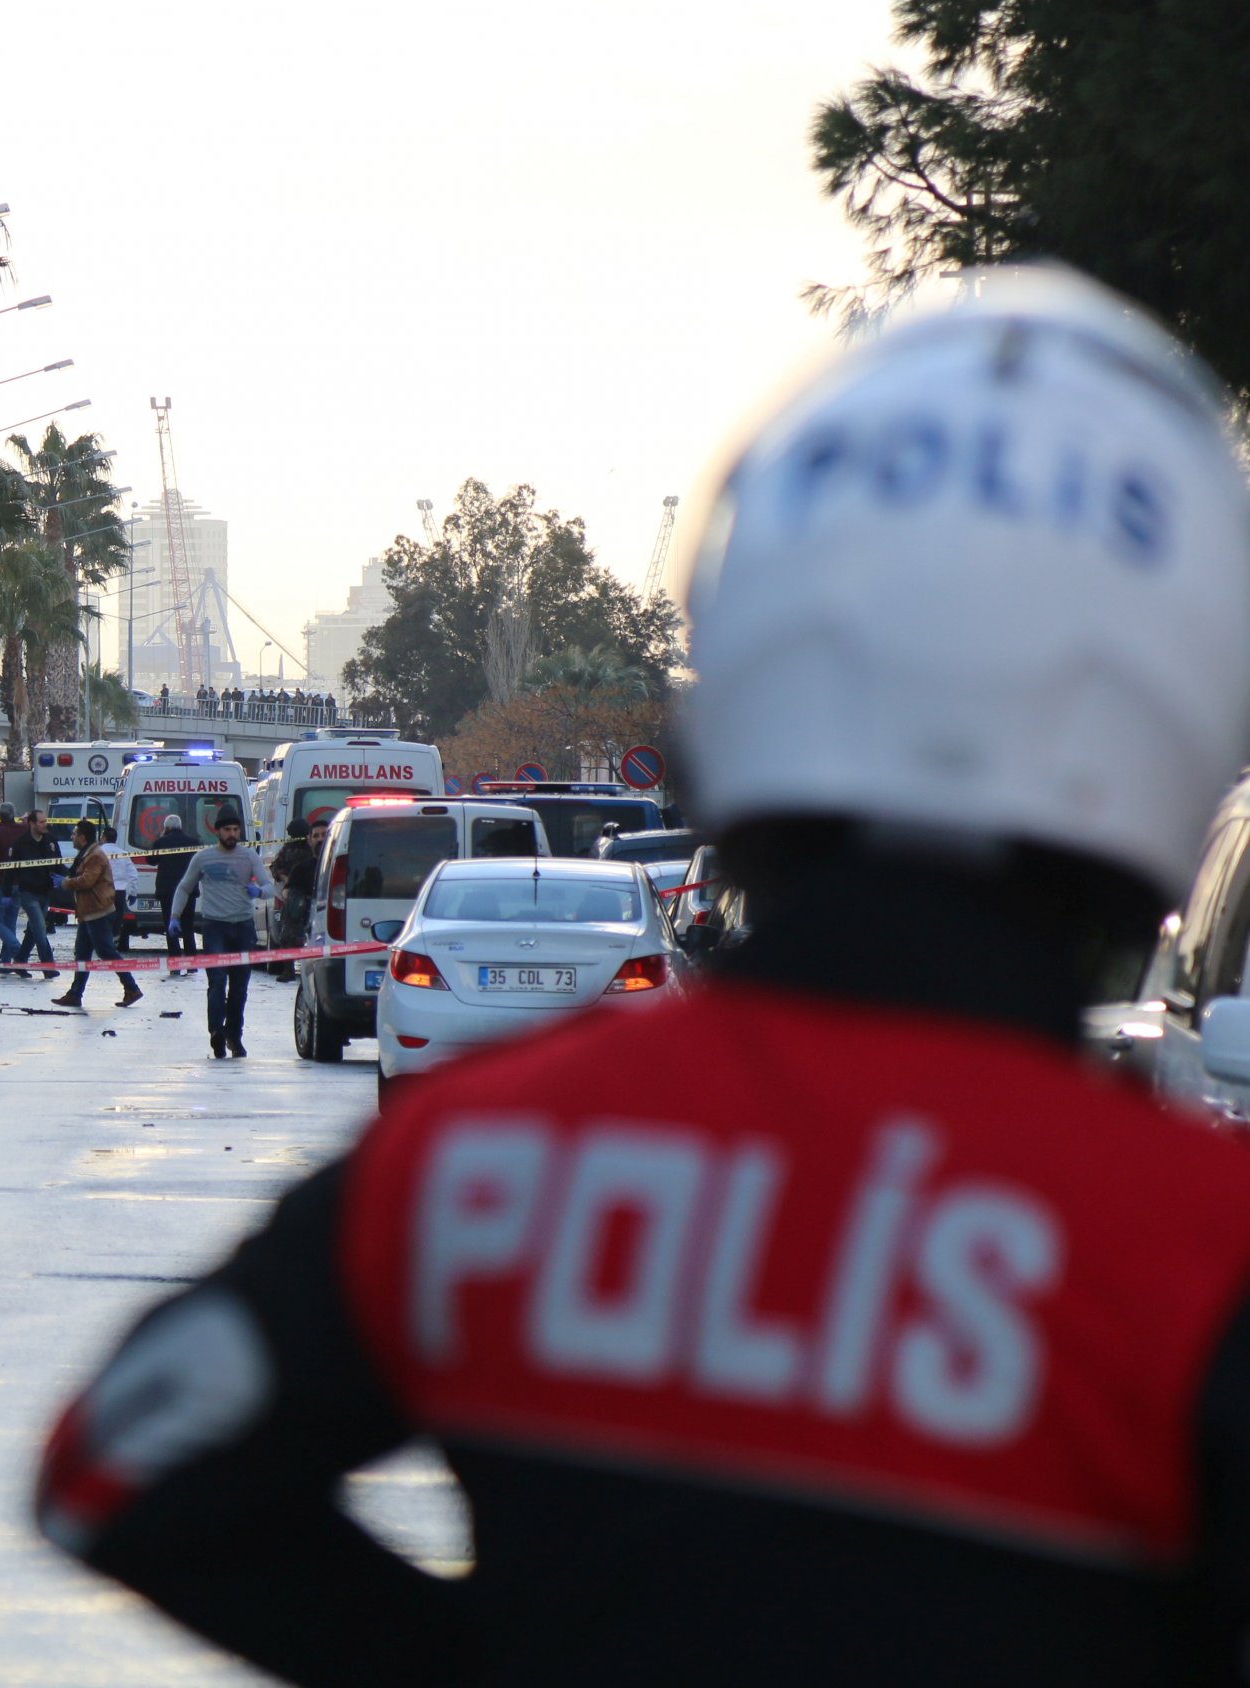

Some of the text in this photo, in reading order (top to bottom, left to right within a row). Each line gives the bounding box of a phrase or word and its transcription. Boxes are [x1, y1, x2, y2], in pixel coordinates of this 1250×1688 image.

[310, 764, 414, 780] AMBULANS
[53, 776, 75, 786] OLAY
[142, 780, 228, 792] AMBULANS
[489, 969, 573, 986] 35 CDL 73
[410, 1113, 1062, 1445] POLİS
